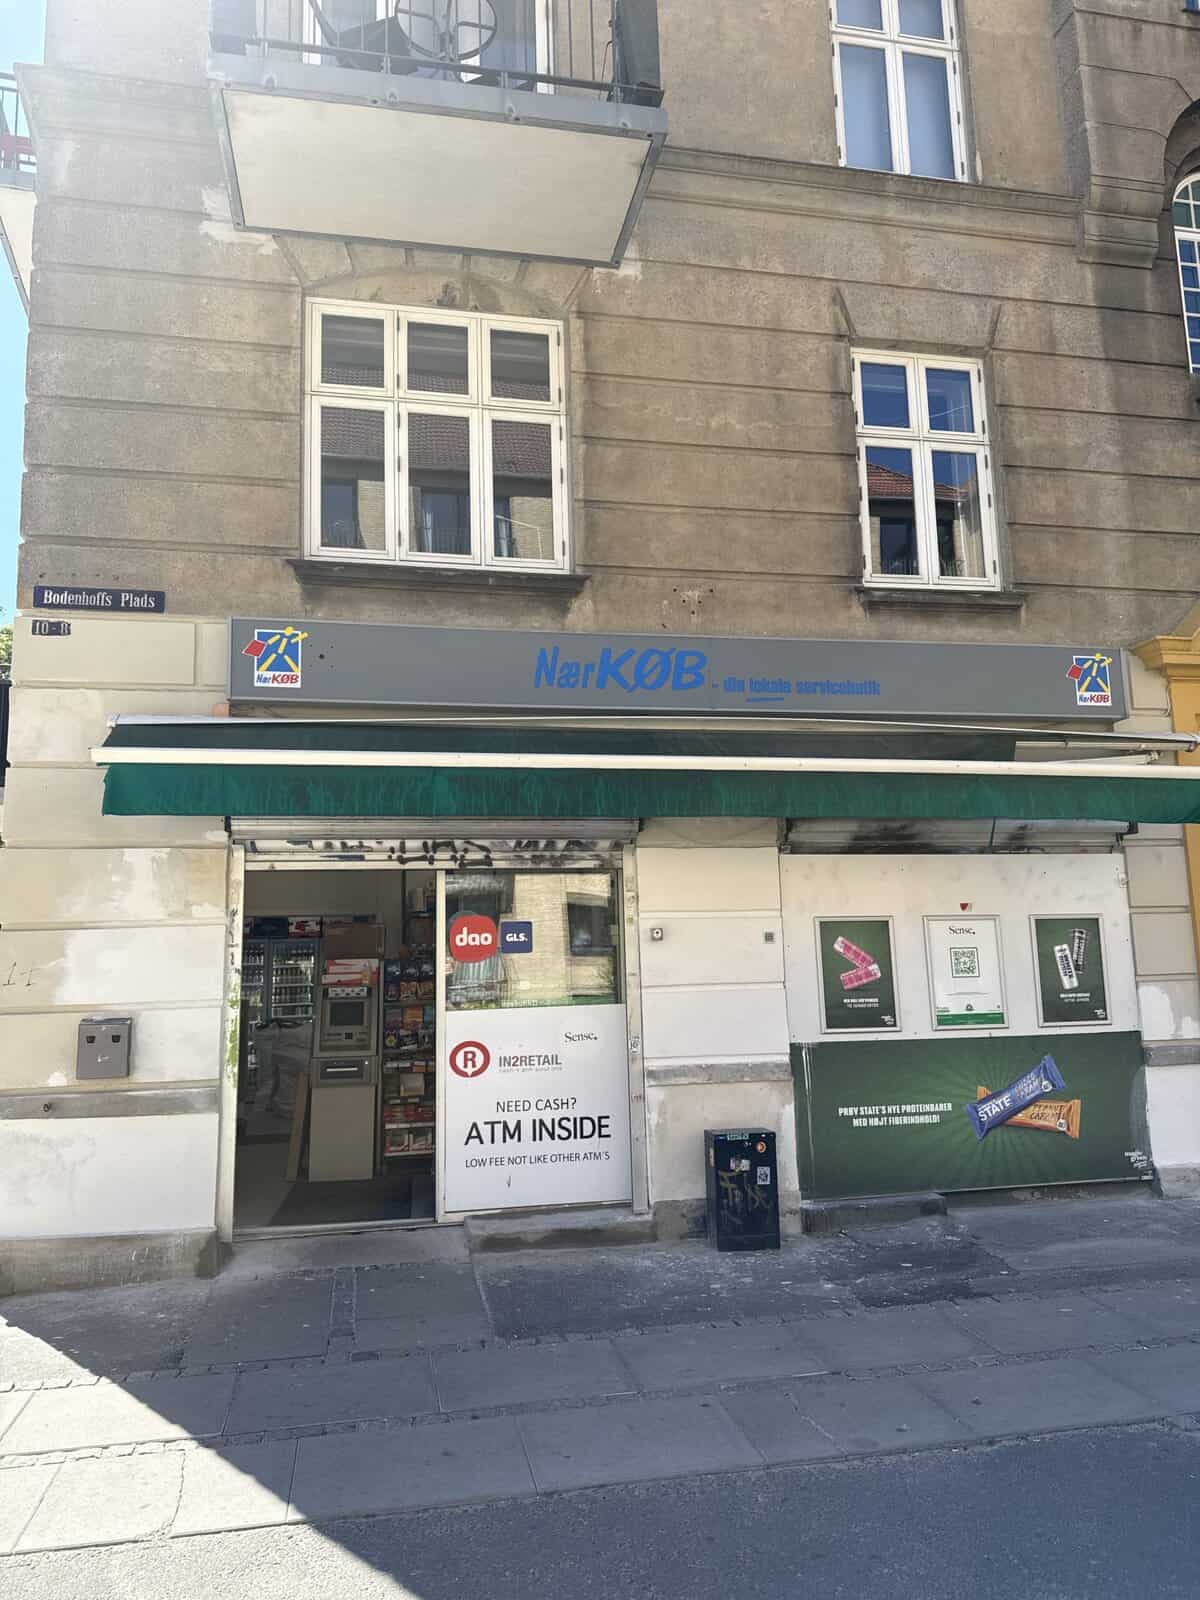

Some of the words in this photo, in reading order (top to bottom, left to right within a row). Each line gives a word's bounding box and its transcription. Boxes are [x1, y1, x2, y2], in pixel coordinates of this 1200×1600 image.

[43, 589, 113, 607] Bodenhoffs
[120, 592, 156, 608] Plads
[34, 621, 49, 635] 10
[256, 673, 299, 684] NærKØB
[533, 645, 708, 693] NærKØB
[455, 926, 493, 947] dao
[463, 1050, 477, 1069] R
[498, 1053, 563, 1068] IN2RETAIL
[496, 1099, 532, 1113] NEED
[535, 1097, 577, 1112] CASH?
[978, 1095, 1013, 1122] STATE
[464, 1118, 522, 1146] ATM
[532, 1115, 612, 1142] INSIDE
[465, 1158, 488, 1169] LOW
[489, 1156, 505, 1167] FEE
[507, 1155, 527, 1166] NOT
[529, 1154, 548, 1165] LIKE
[549, 1152, 581, 1164] OTHER
[582, 1150, 611, 1162] ATM'S
